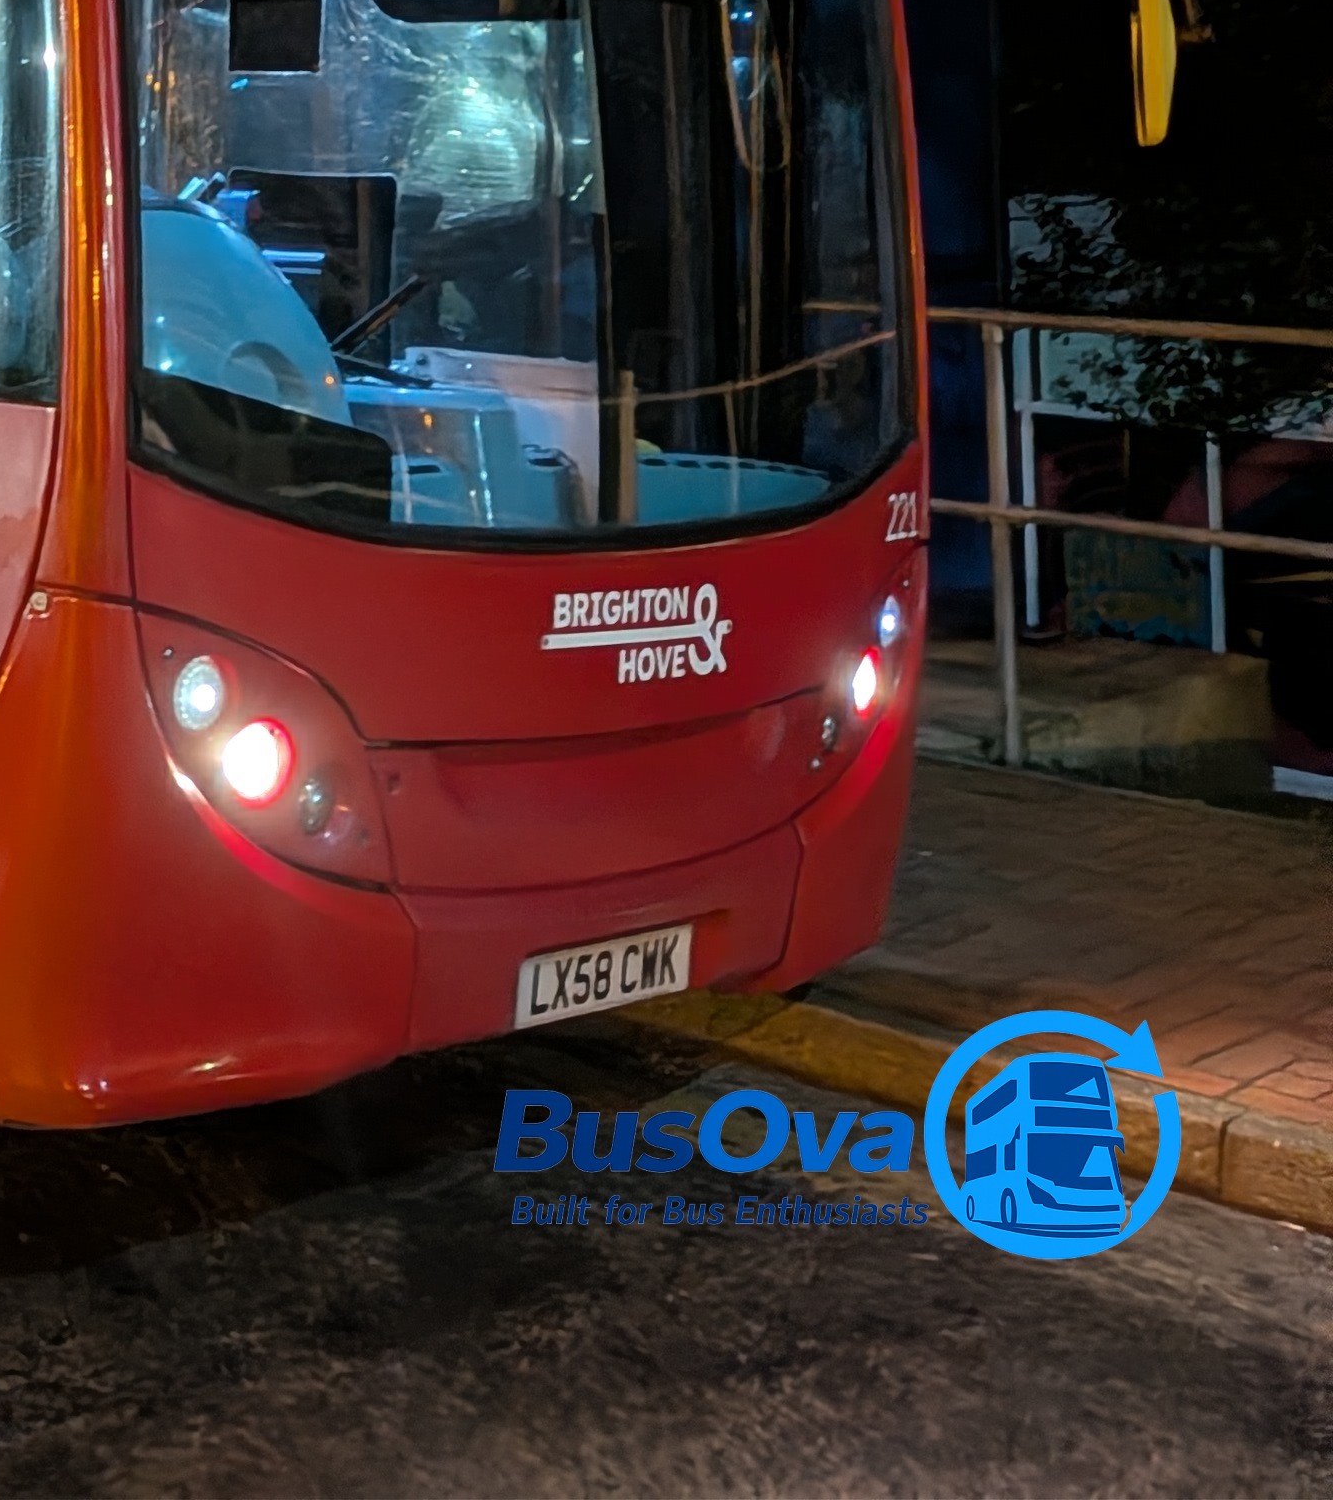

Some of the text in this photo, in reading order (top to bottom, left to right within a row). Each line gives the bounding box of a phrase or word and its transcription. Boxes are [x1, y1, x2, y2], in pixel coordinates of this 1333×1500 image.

[884, 490, 919, 543] 221
[552, 585, 690, 628] BRIGHTON
[617, 644, 688, 685] HOVE
[528, 933, 679, 1016] LX58 CWK
